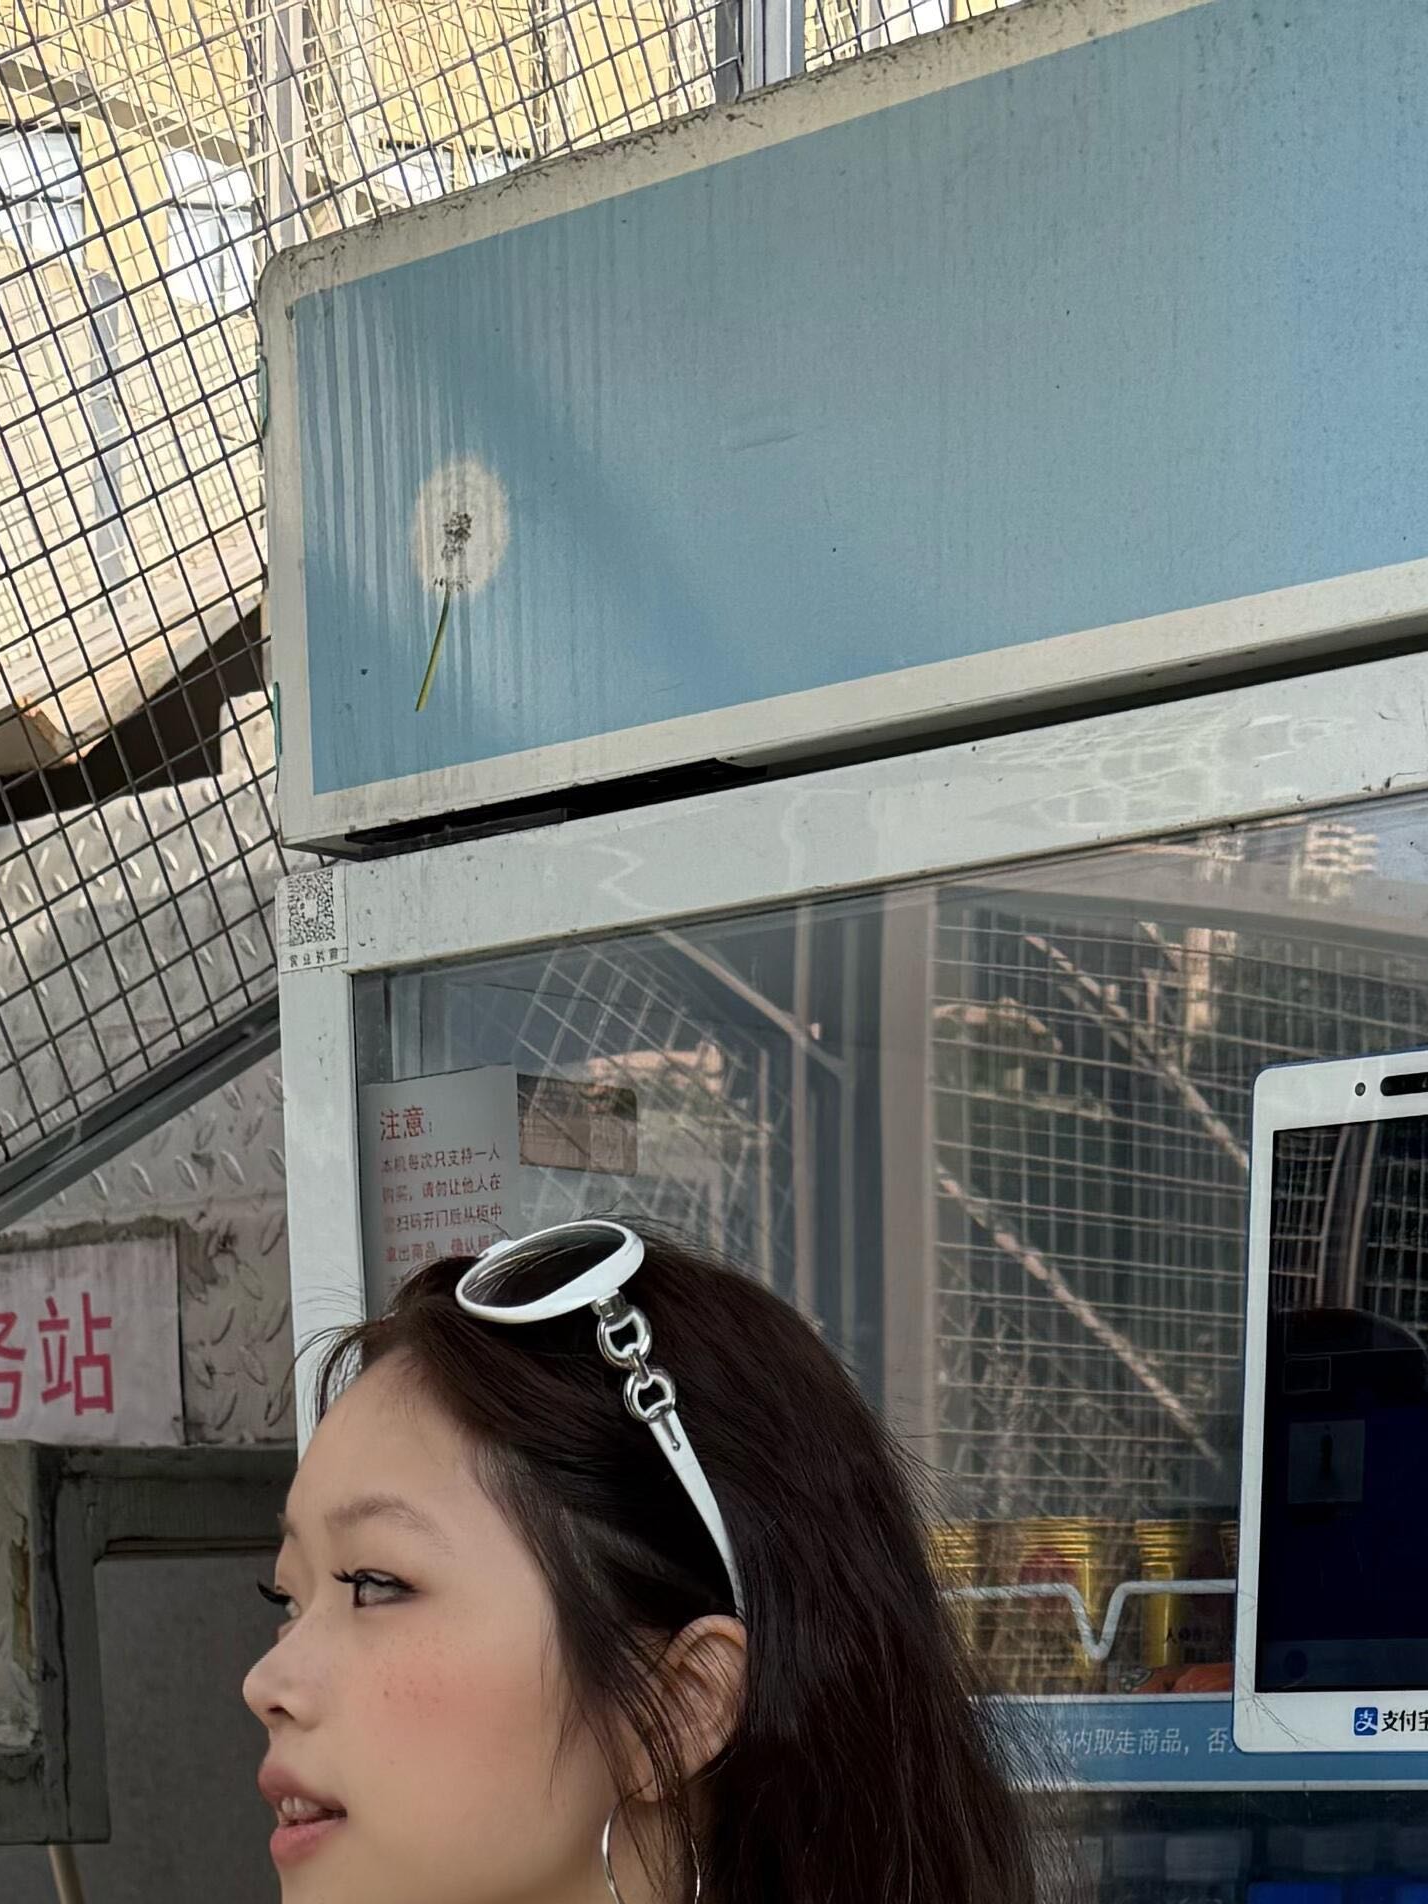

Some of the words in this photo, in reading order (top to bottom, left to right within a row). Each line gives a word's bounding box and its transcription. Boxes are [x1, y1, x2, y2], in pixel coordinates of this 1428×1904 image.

[1054, 1726, 1240, 1757] 内取走商品，否
